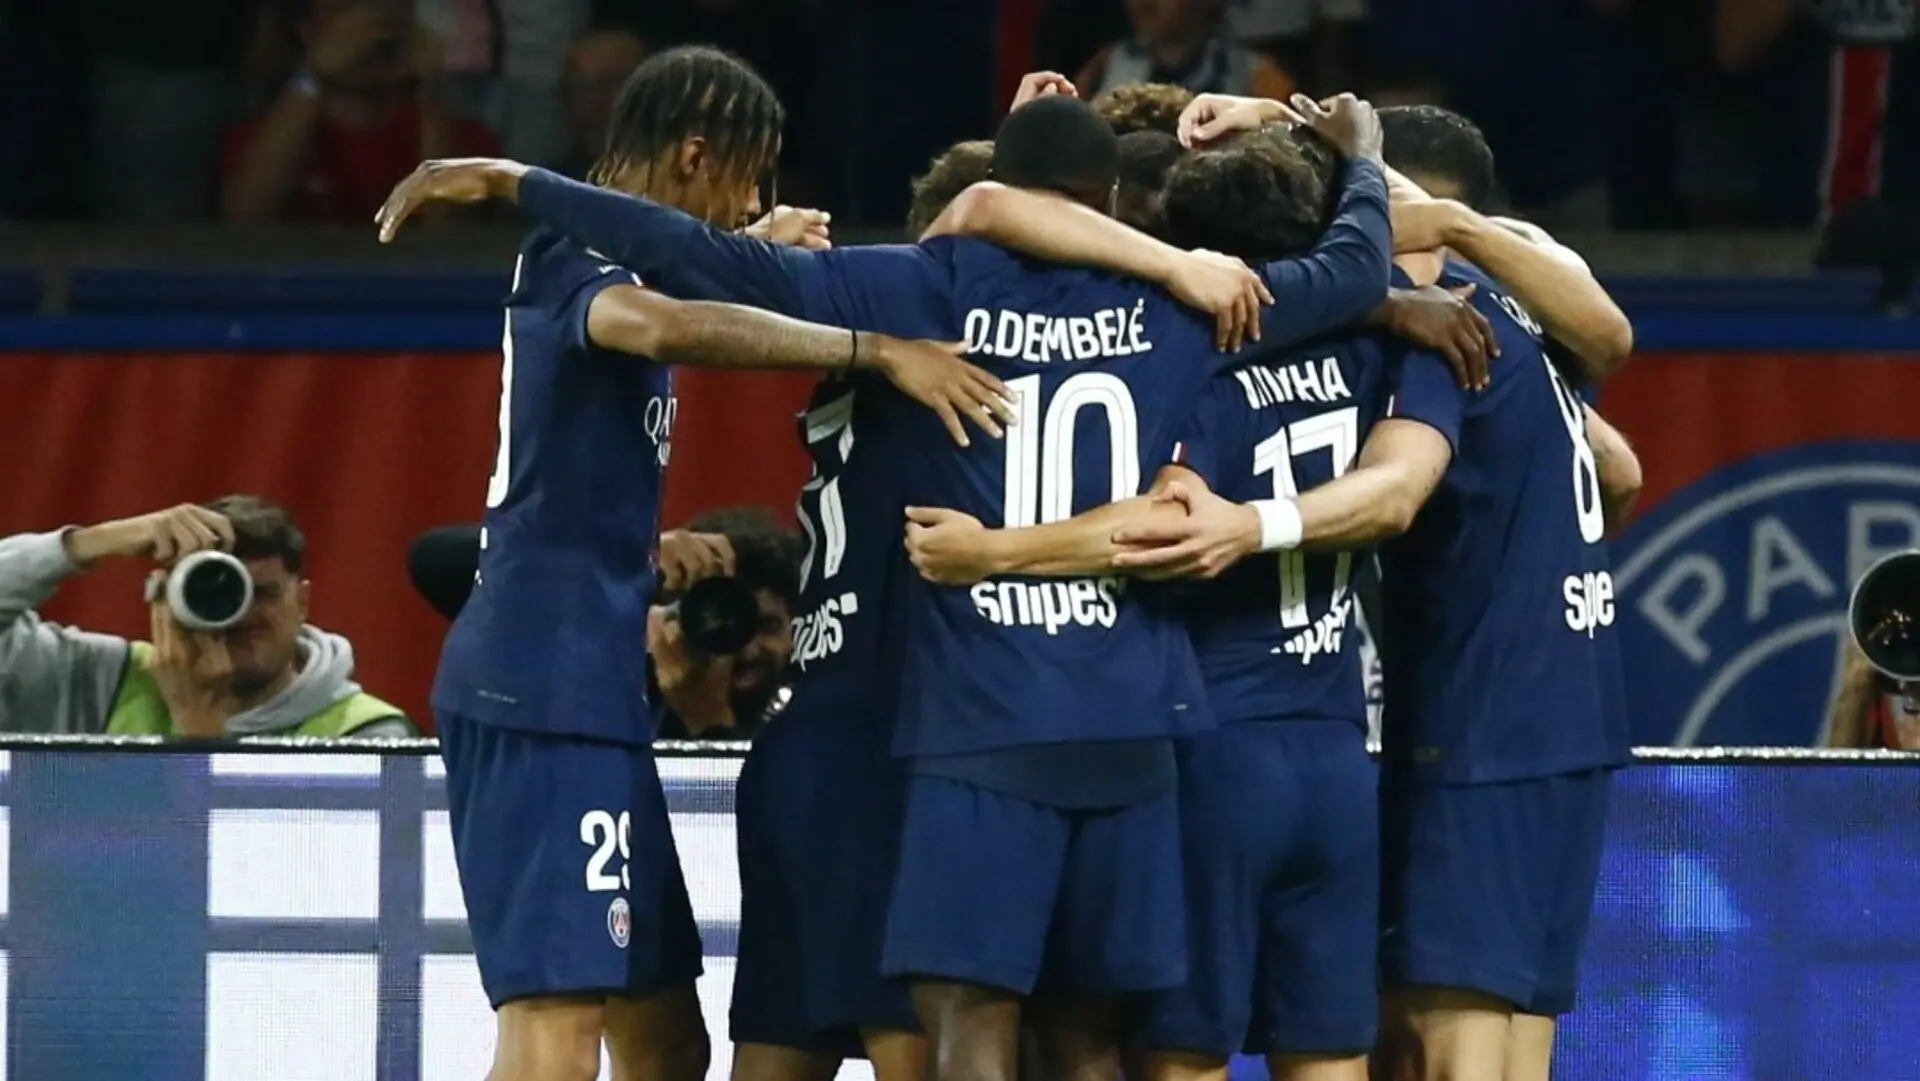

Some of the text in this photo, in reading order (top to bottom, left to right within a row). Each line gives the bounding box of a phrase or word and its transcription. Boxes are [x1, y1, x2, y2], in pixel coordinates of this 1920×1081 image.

[1003, 371, 1140, 529] 10
[1253, 406, 1358, 628] 17
[970, 578, 1117, 635] snipes
